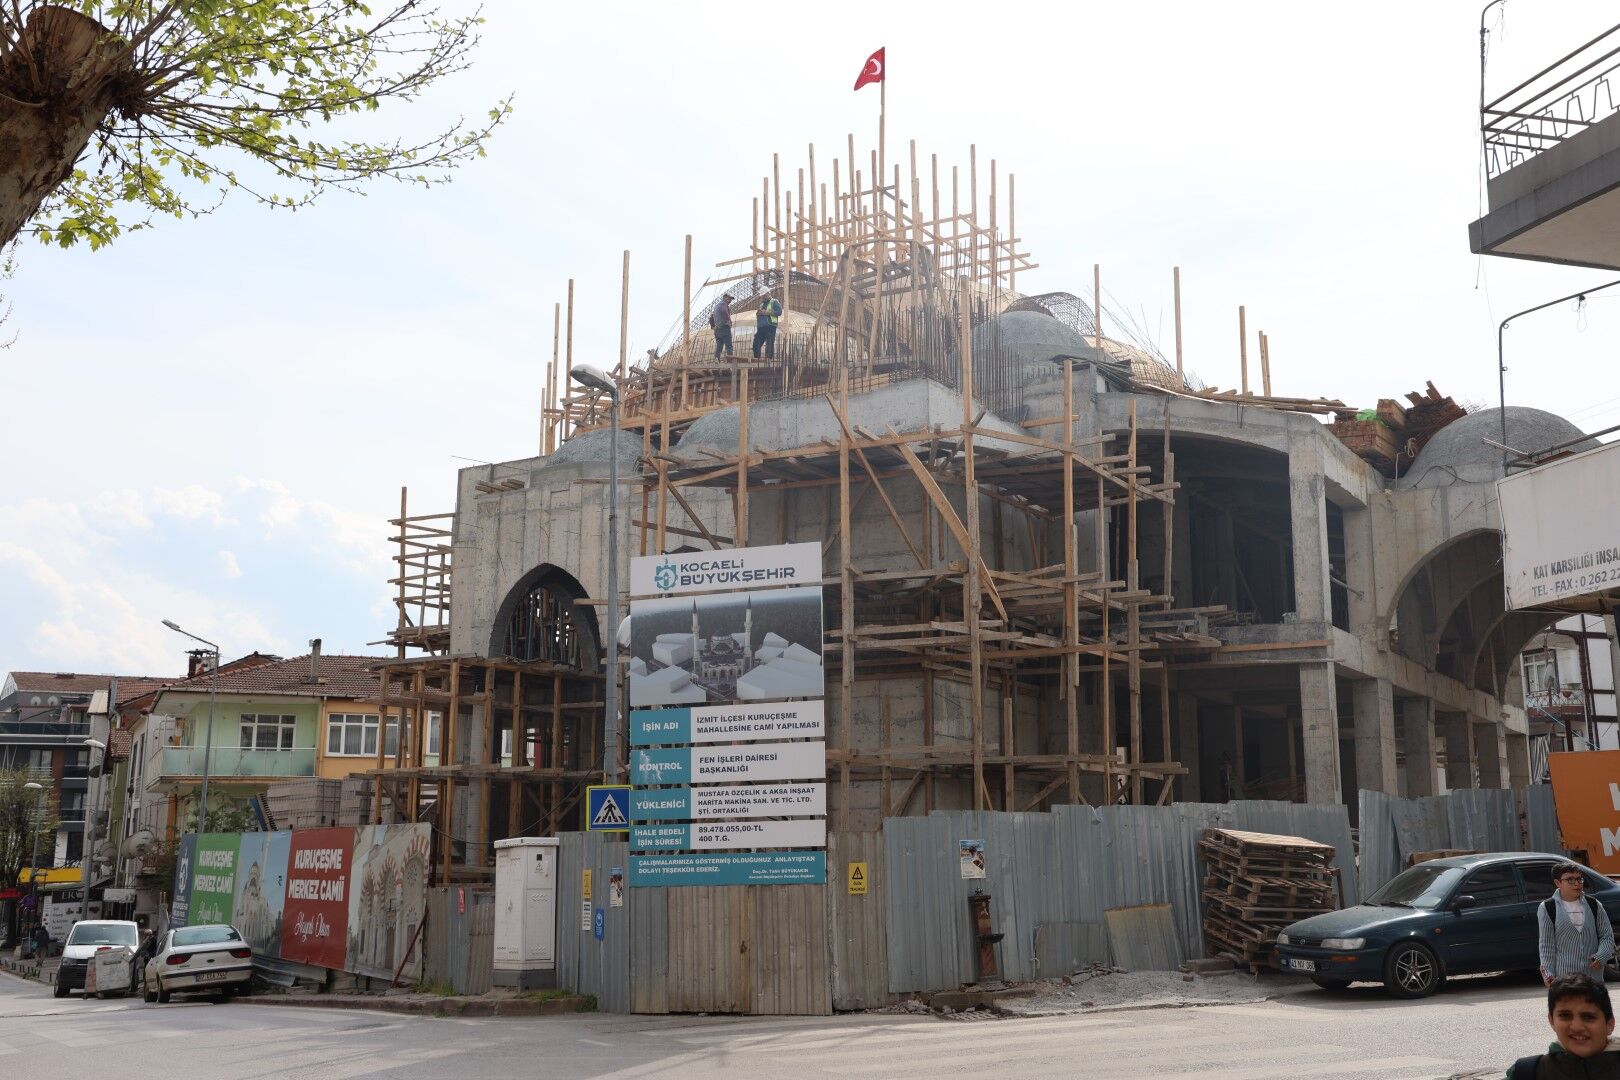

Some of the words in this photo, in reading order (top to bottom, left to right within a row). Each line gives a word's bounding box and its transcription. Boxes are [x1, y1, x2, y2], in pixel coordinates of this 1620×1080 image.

[680, 559, 744, 573] KOCAELİ
[1533, 564, 1548, 580] KAT
[1551, 552, 1594, 576] KARŞILIĞI
[1595, 547, 1620, 566] İNŞA
[680, 567, 796, 586] BÜYÜKŞEHİR
[1531, 584, 1548, 598] TEL
[1555, 578, 1573, 593] FAX
[1580, 575, 1587, 587] 0
[1588, 571, 1608, 586] 262
[696, 715, 719, 724] İZMİT
[720, 714, 746, 723] İLÇESİ
[747, 712, 798, 722] KURUÇEŞME
[642, 721, 661, 732] İŞİN
[696, 724, 752, 734] MAHALLESİNE
[754, 722, 774, 731] CAMİ
[776, 721, 820, 730] YAPILMASI
[717, 754, 743, 764] İŞLERİ
[745, 753, 778, 762] DAİRESİ
[639, 762, 683, 771] KONTROL
[699, 765, 749, 774] BAŞKANLIĞI
[636, 799, 685, 810] YÜKLENİCİ
[634, 828, 657, 836] İHALE
[658, 827, 685, 836] BEDELİ
[637, 838, 653, 847] İŞİN
[655, 837, 682, 846] SÜRESİ
[198, 850, 234, 871] KURUÇEŞME
[294, 848, 343, 873] KURUÇEŞME
[638, 858, 694, 867] ÇALIŞMALARIMIZA
[695, 857, 731, 865] GÖSTERMİŞ
[732, 856, 772, 864] OLDUĞUNUZ
[662, 866, 695, 874] TEŞEKKÜR
[696, 865, 720, 873] EDERİZ.
[193, 874, 217, 893] MERKEZ
[288, 879, 320, 900] MERKEZ
[320, 875, 345, 902] CAMİİ
